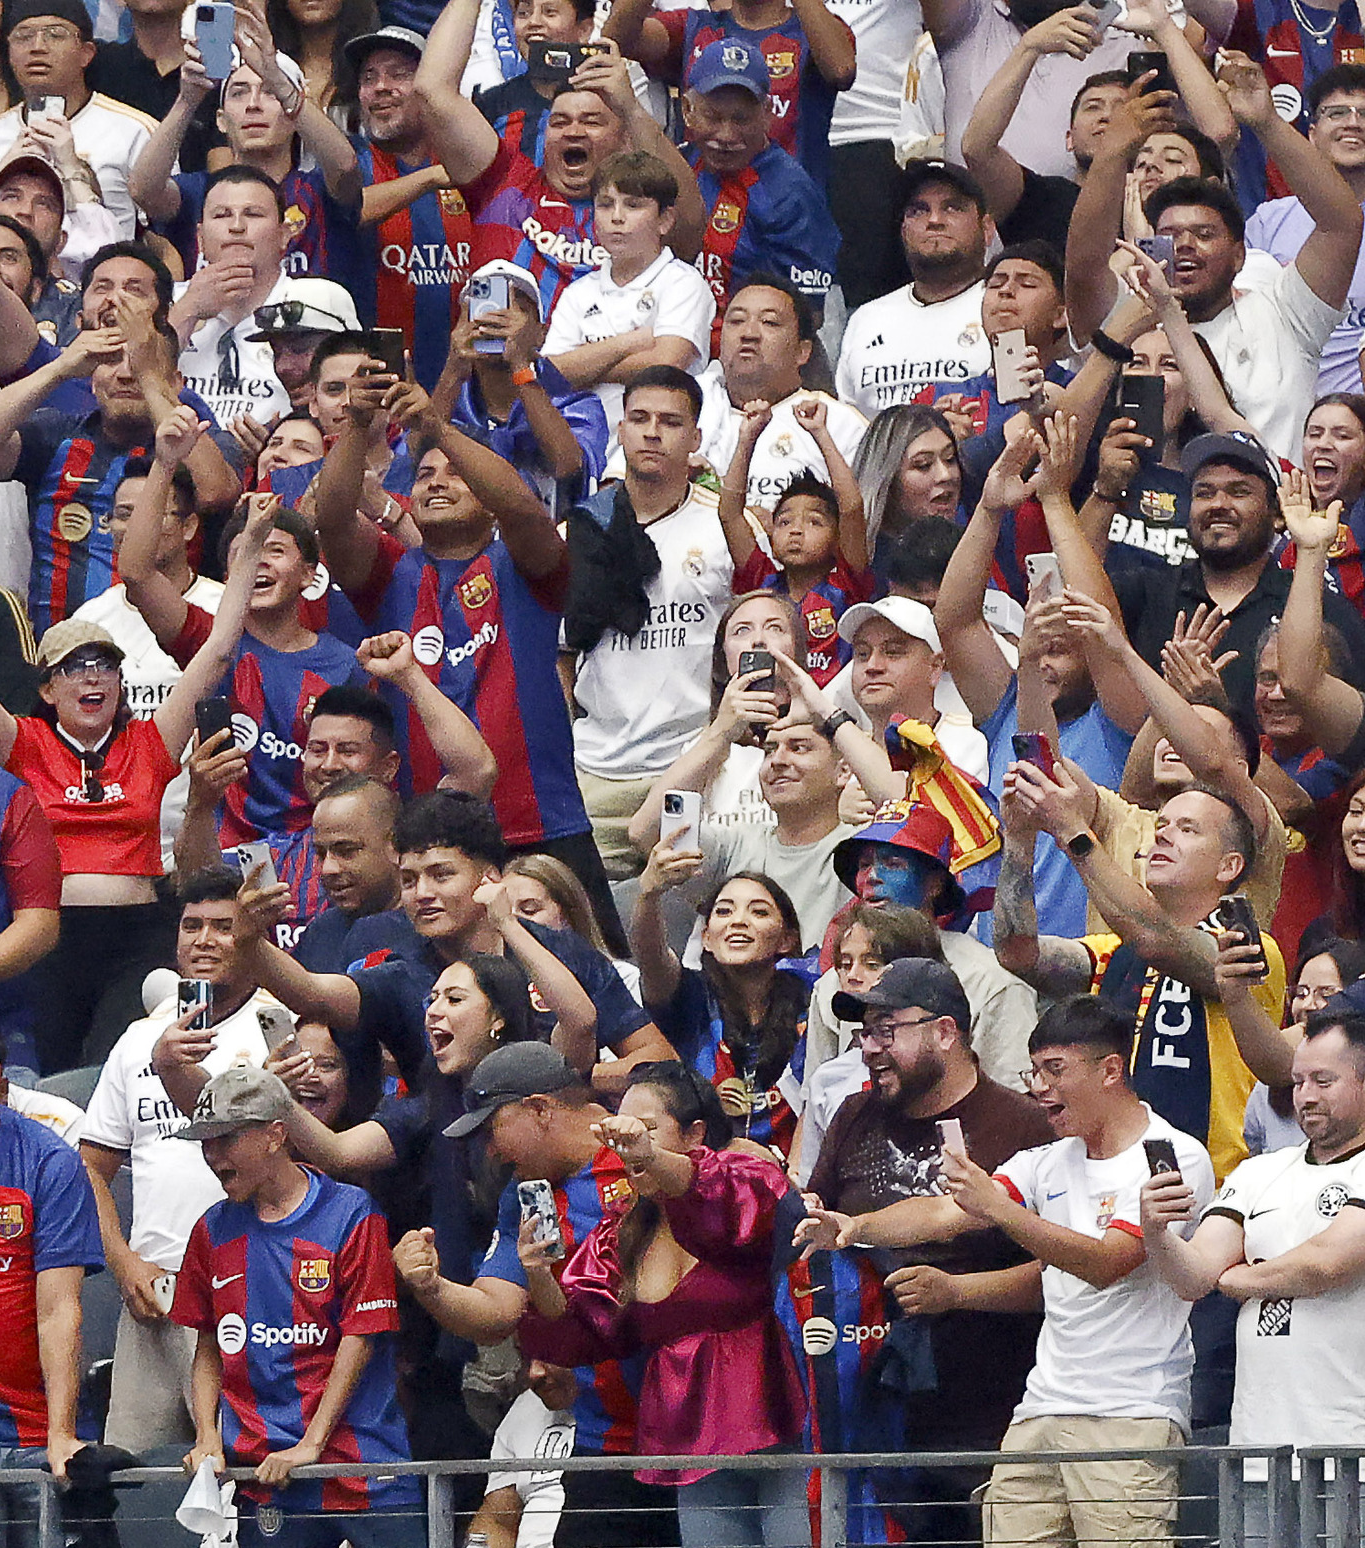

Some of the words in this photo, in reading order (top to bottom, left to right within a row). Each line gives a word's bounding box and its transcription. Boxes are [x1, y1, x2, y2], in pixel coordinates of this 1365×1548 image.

[381, 242, 471, 275] QATAR
[791, 265, 832, 286] beko
[861, 358, 970, 389] Emirates
[640, 627, 686, 650] BETTER
[261, 732, 305, 761] Spo
[64, 784, 122, 803] adas
[250, 1322, 329, 1348] Spotify
